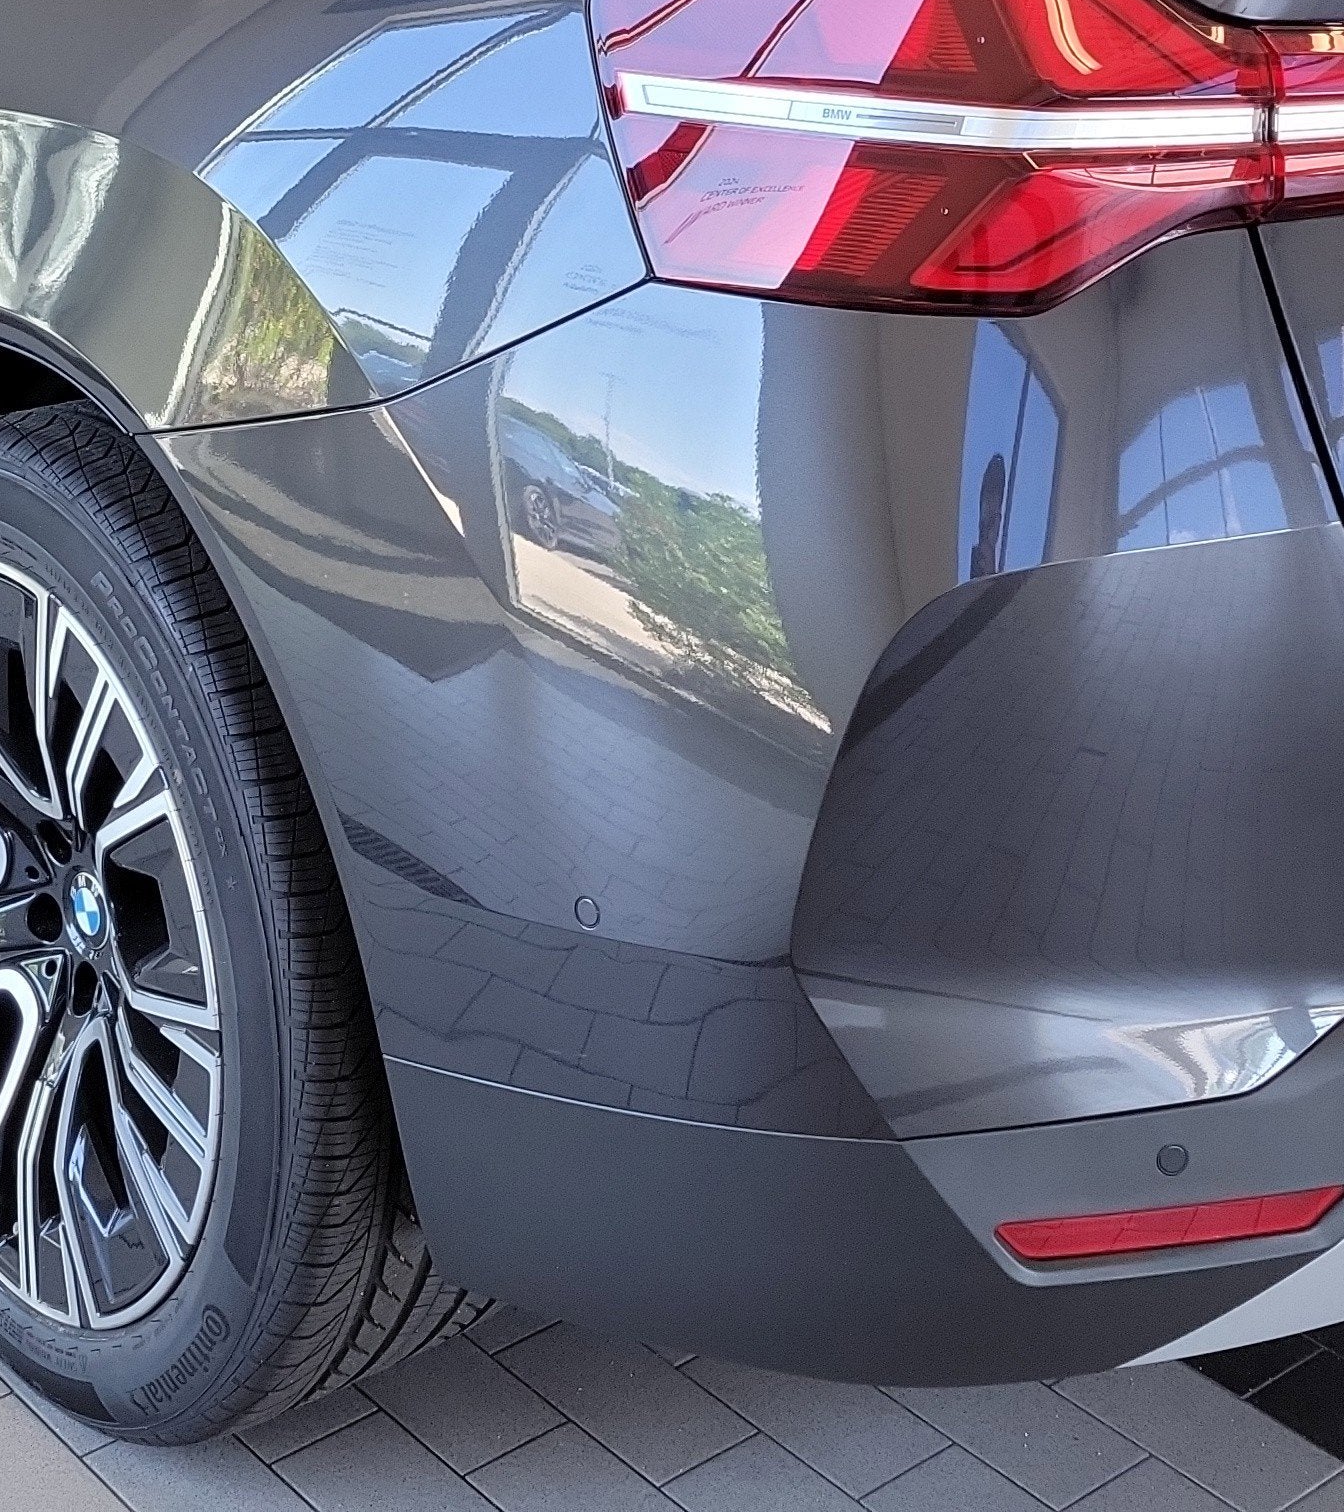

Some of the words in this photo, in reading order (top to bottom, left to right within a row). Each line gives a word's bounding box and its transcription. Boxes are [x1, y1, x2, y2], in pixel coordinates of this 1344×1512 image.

[822, 108, 852, 121] BMW
[70, 875, 100, 901] BMW
[140, 1303, 231, 1414] Continental
